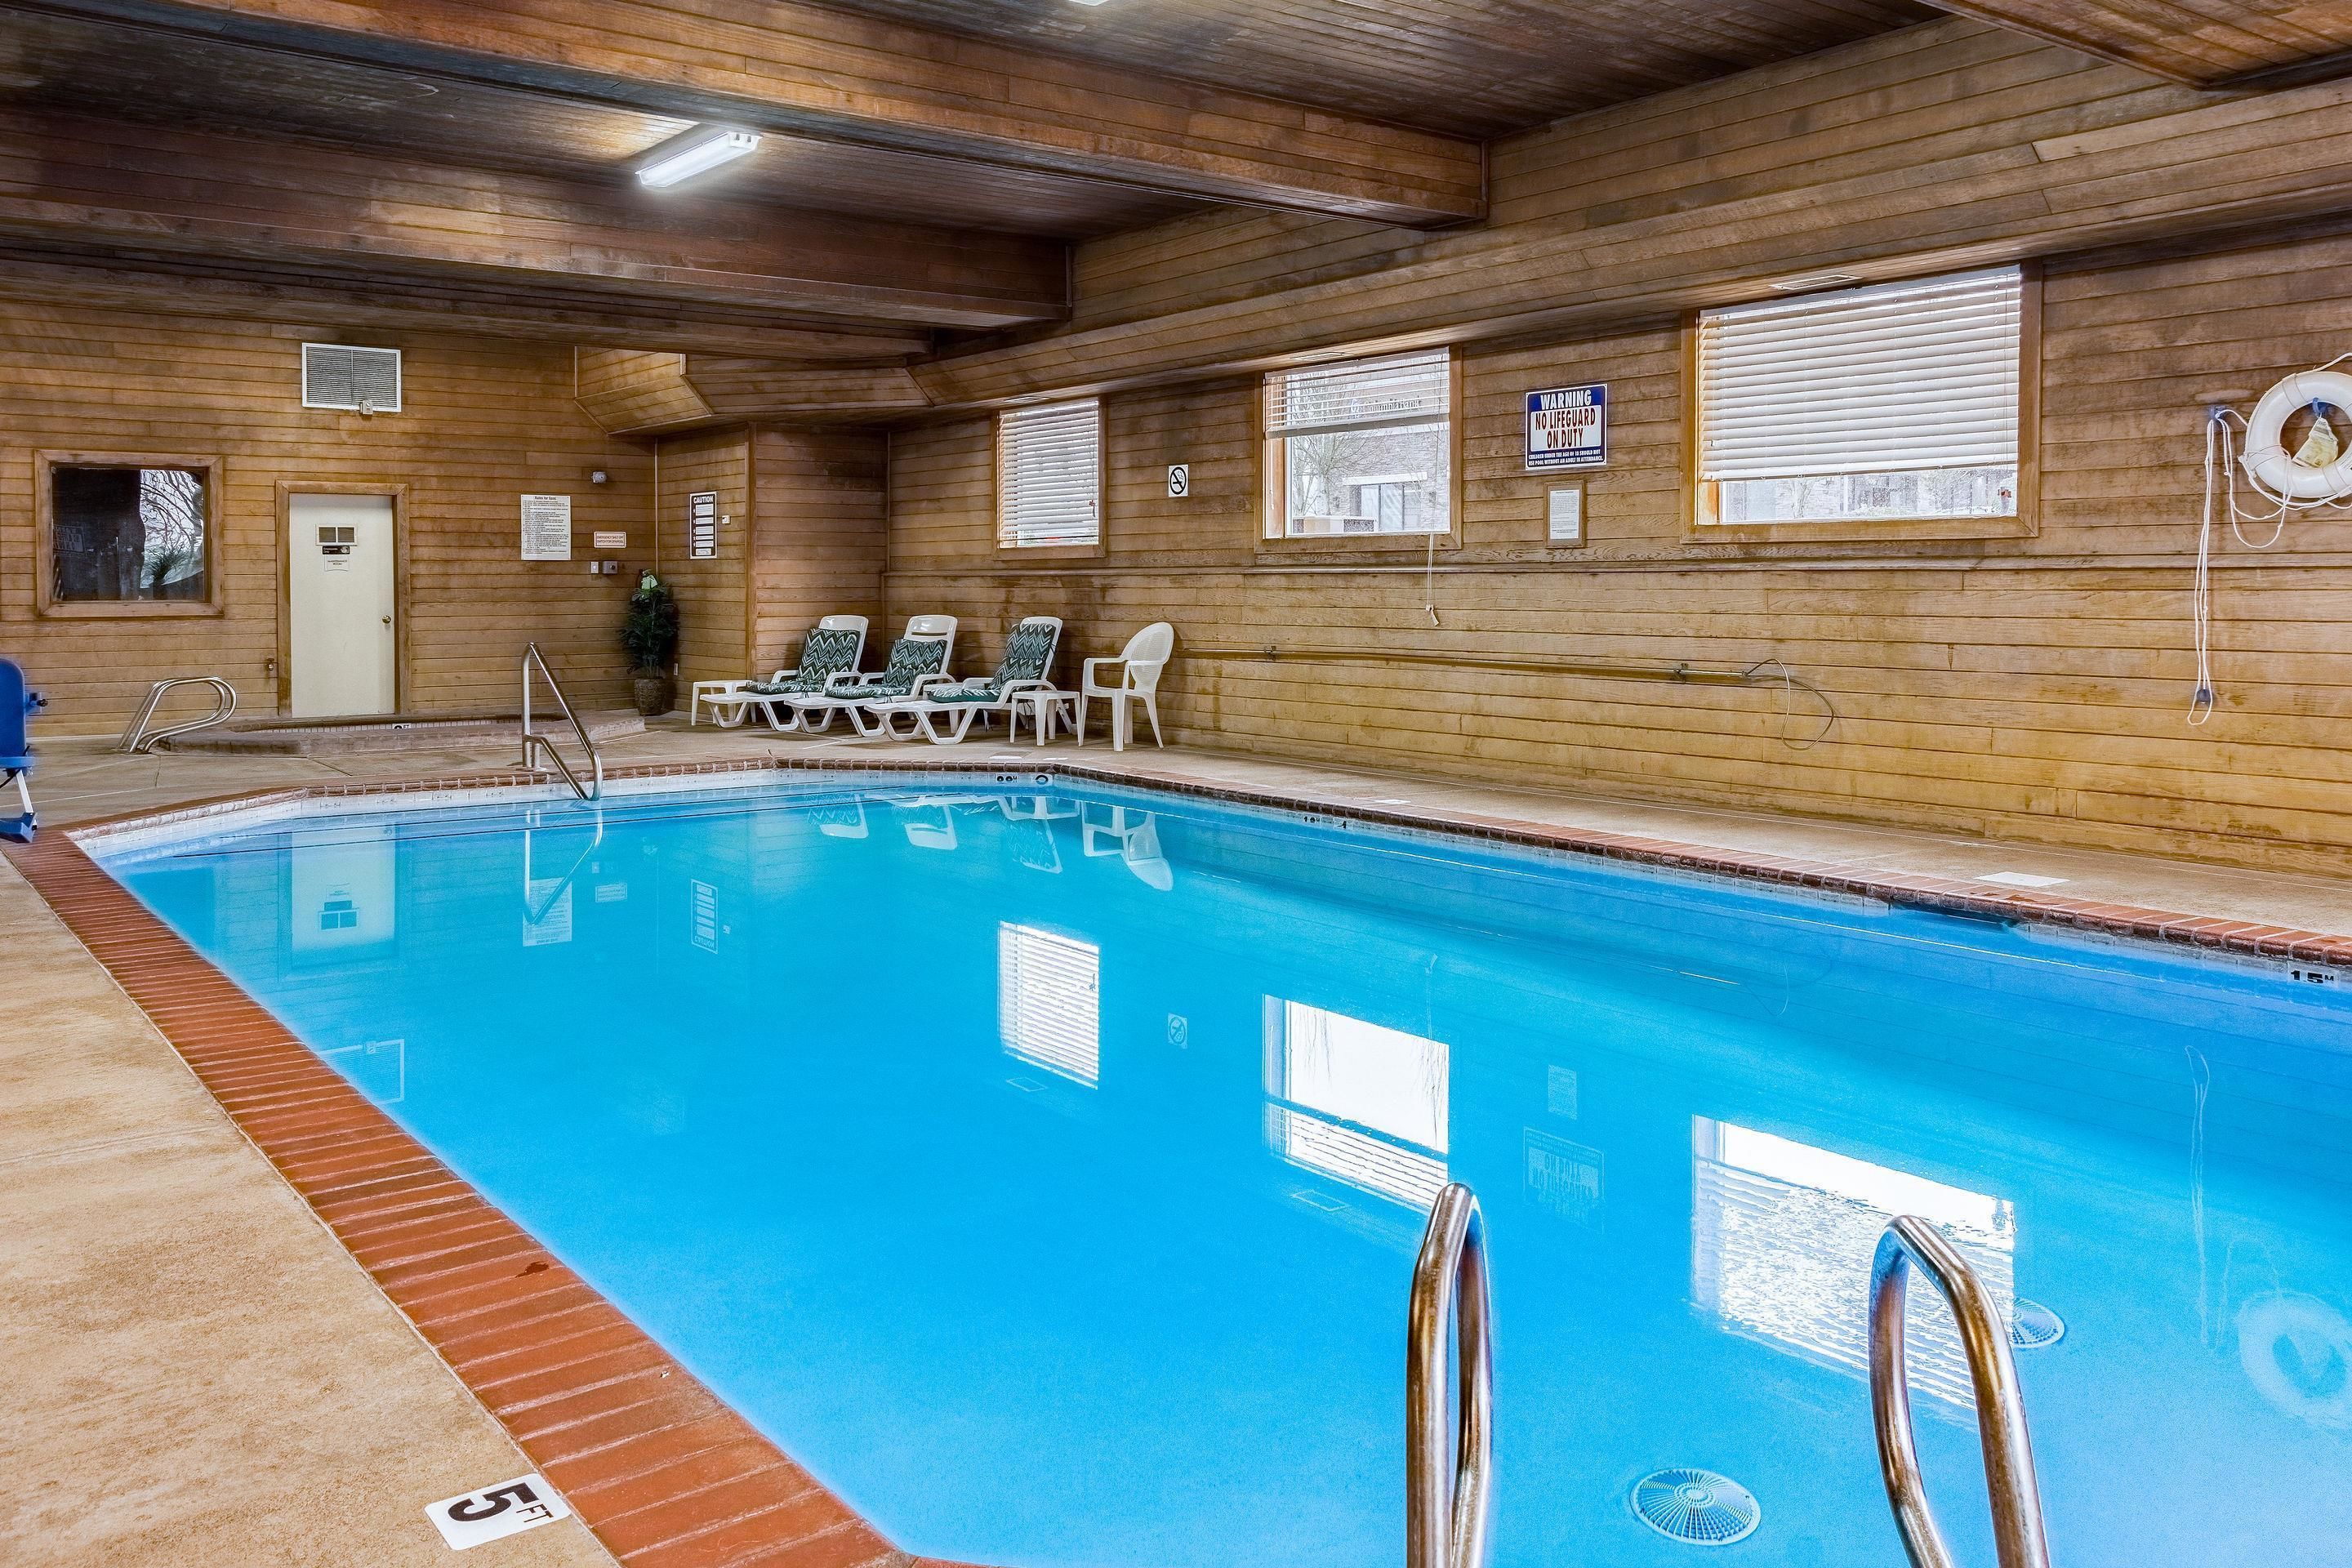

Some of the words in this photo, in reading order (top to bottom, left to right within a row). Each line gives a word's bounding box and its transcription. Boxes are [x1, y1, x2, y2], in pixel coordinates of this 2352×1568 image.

[1540, 390, 1592, 410] WARNING
[1535, 412, 1547, 430] NO
[1550, 408, 1596, 429] LIFEGUARD
[1547, 430, 1558, 448] ON
[1561, 428, 1583, 448] DUTY
[693, 496, 714, 504] CAUTION
[448, 1482, 540, 1521] 5
[516, 1503, 554, 1522] FT
